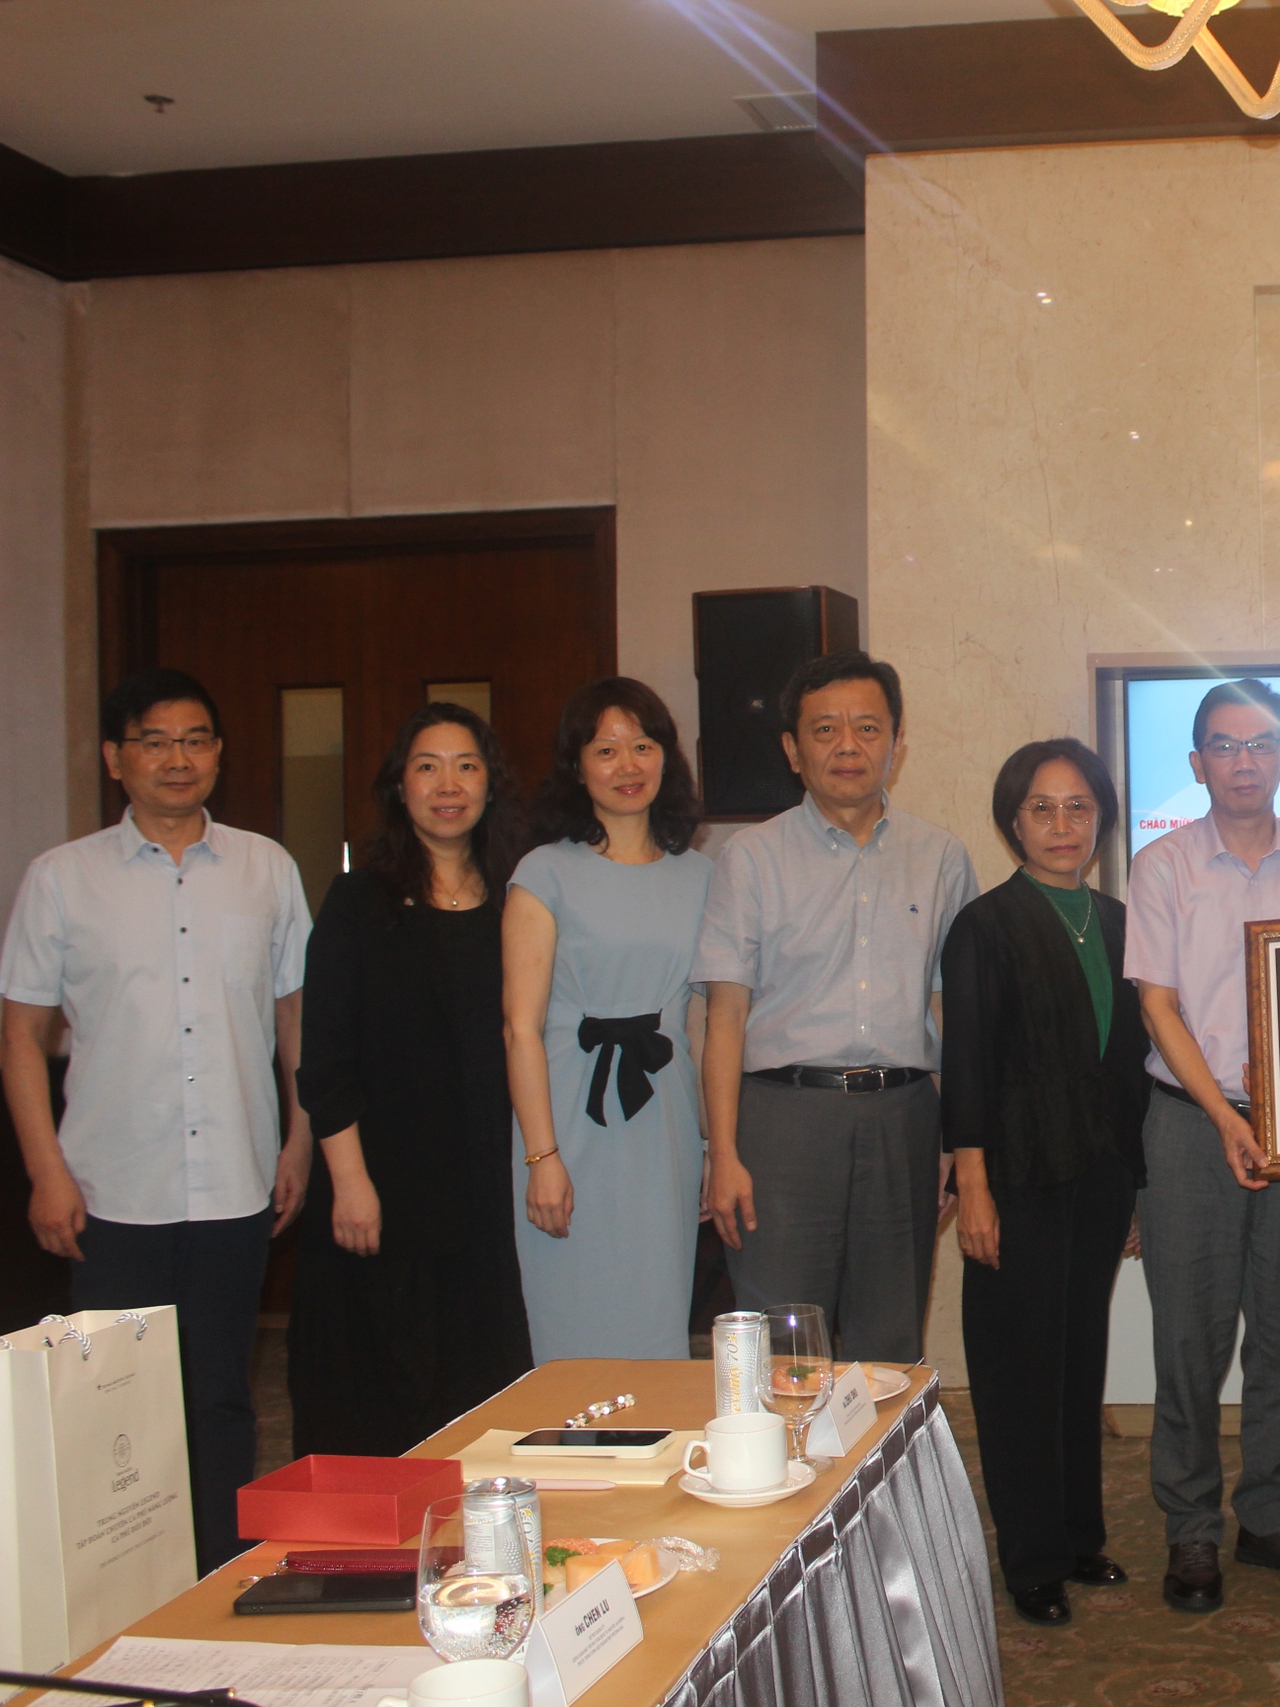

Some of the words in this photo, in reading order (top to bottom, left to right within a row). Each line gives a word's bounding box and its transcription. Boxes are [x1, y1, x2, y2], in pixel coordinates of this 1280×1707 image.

[1139, 817, 1167, 830] CHÀO
[112, 1469, 140, 1493] Legend
[583, 1605, 602, 1629] CHEN
[599, 1598, 610, 1615] LU
